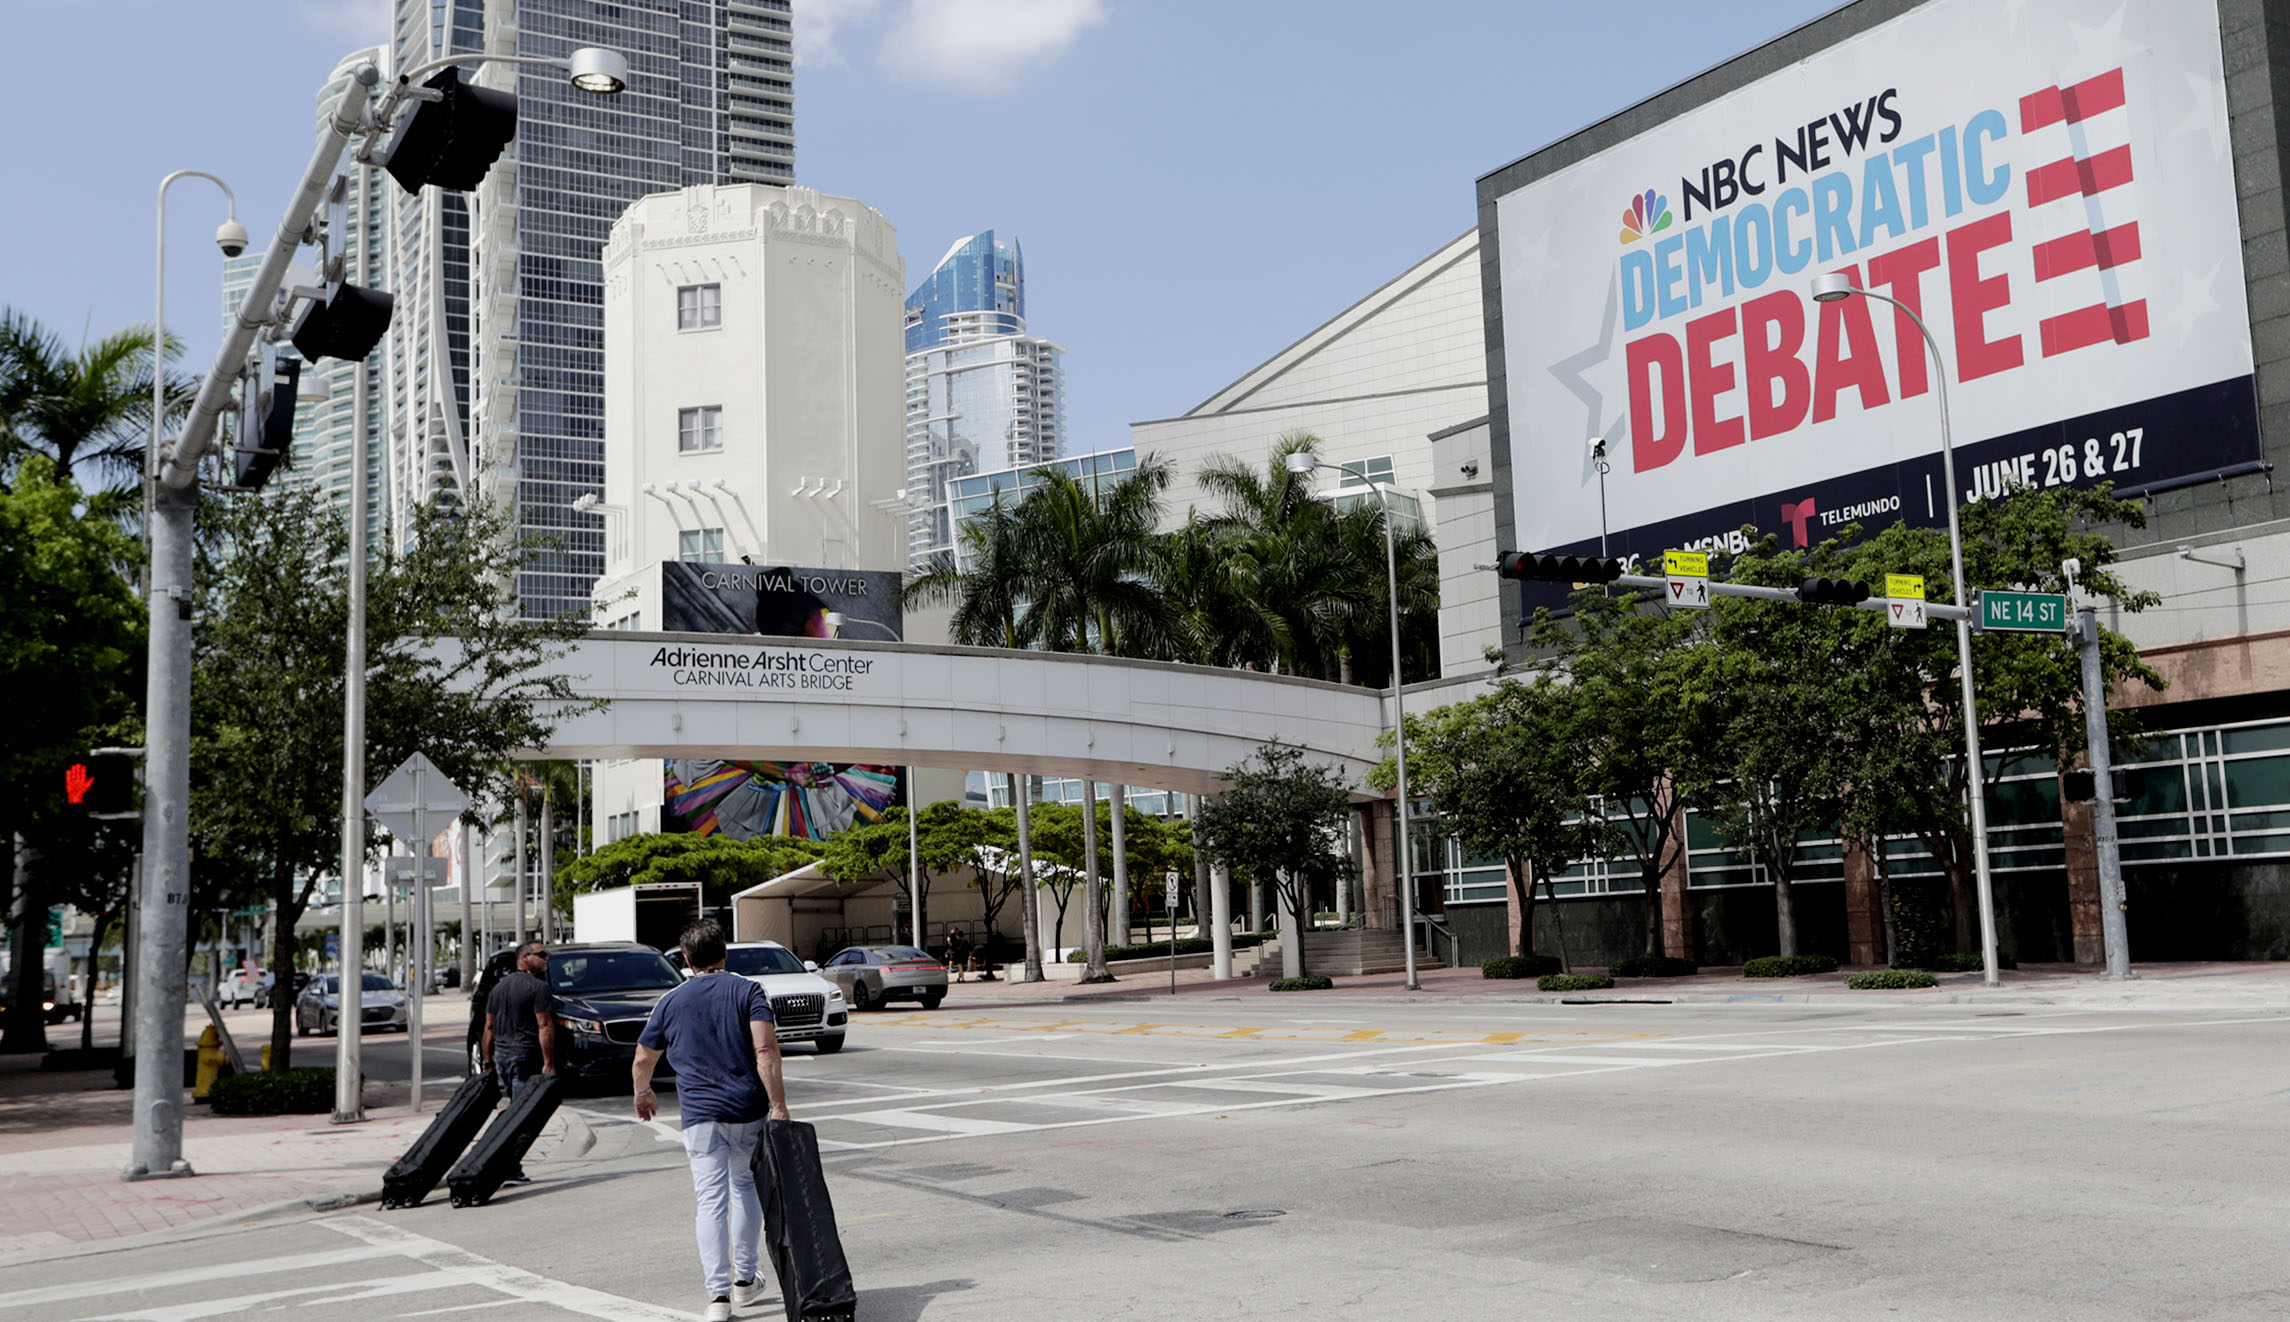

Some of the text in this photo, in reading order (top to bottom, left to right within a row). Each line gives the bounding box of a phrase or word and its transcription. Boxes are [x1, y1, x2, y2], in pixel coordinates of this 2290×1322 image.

[1681, 88, 1902, 222] NBC NEWS
[1620, 109, 2011, 332] DEMOCRATIC
[1625, 209, 2025, 474] DEBATE
[1966, 427, 2144, 504] JUNE 26 & 27
[1820, 495, 1900, 526] TELEMUNDO
[1679, 555, 1704, 564] TURNING
[1679, 565, 1706, 574] VEHICLES
[701, 571, 868, 596] CARNIVAL TOWER
[1991, 600, 2056, 622] NE 14 ST
[650, 647, 873, 674] Adrienne Arsht Center
[673, 669, 854, 690] CARNIVAL ARTS BRIDGE
